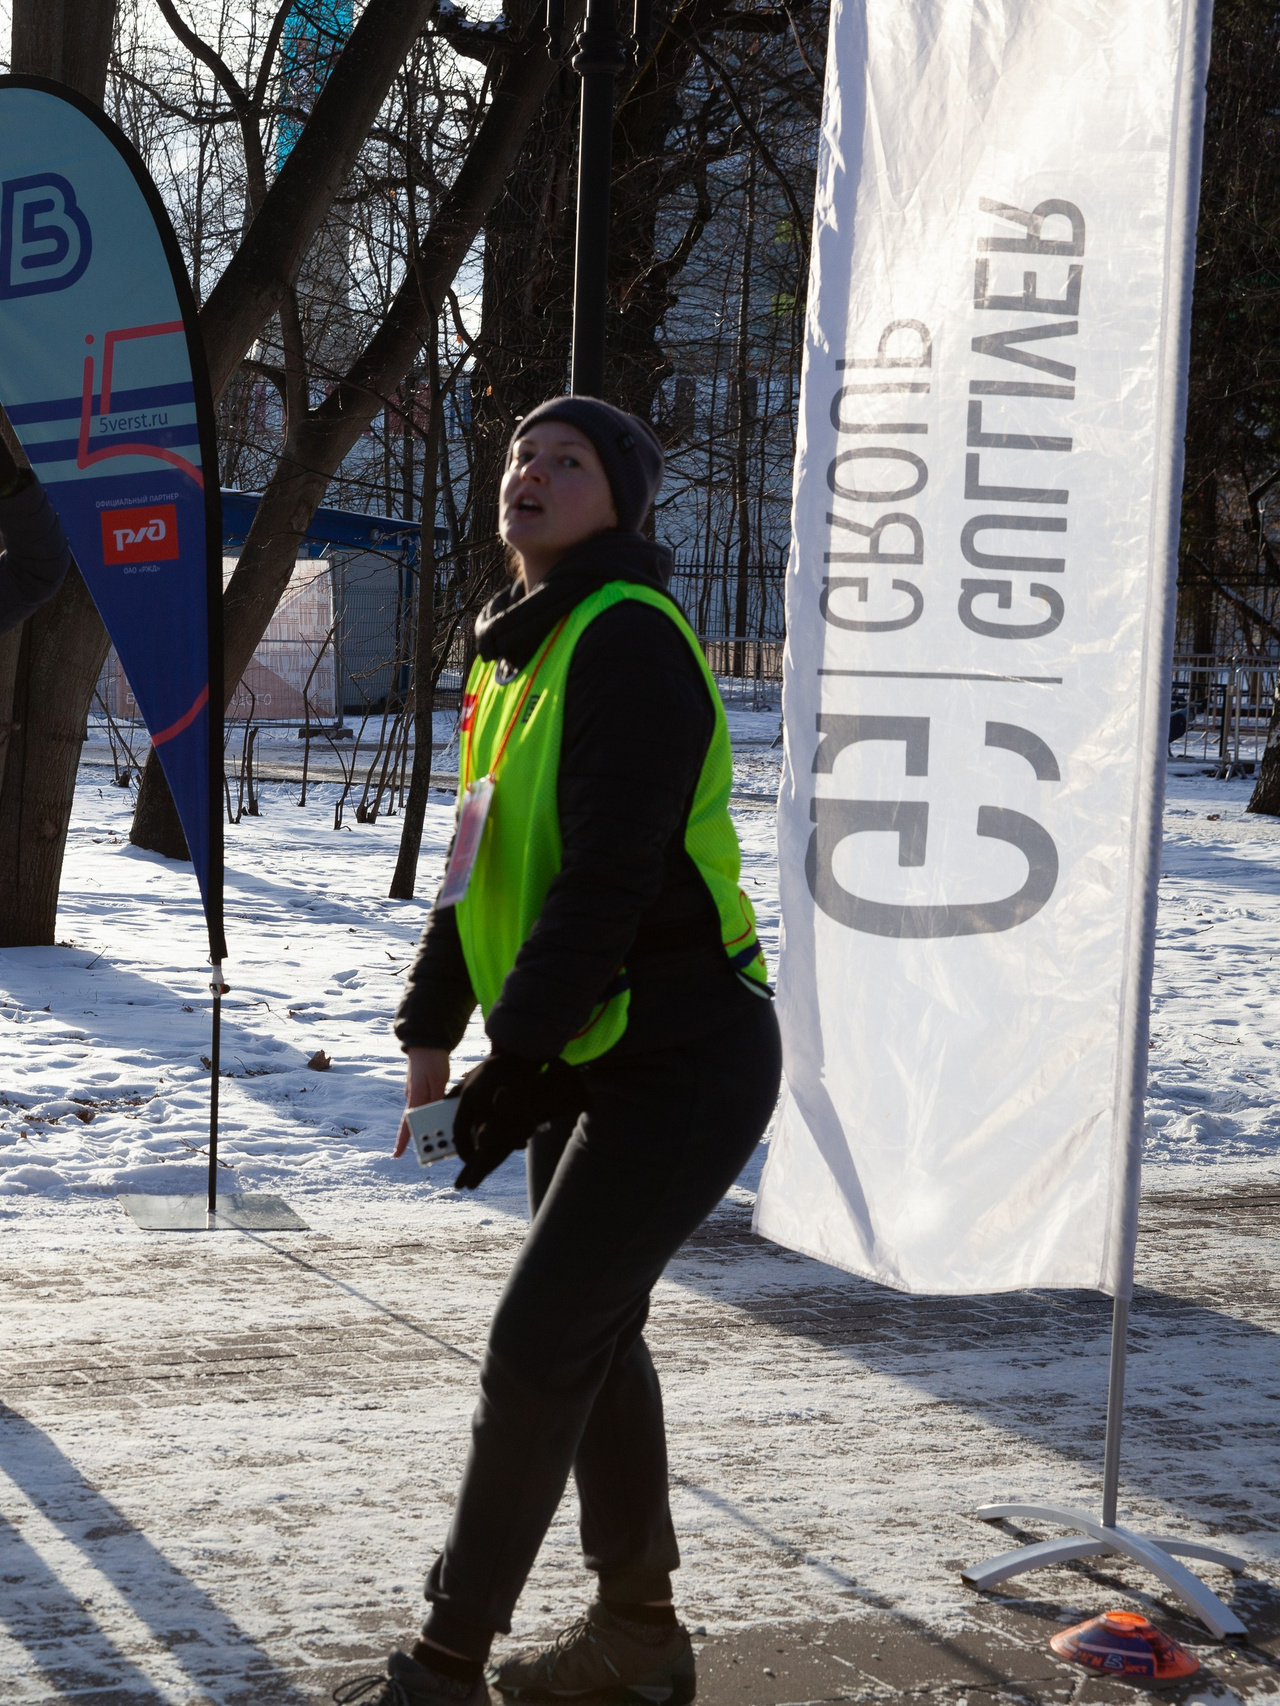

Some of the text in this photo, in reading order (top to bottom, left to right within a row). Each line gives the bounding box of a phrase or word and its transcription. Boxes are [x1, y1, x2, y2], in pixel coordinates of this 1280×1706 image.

[99, 411, 169, 433] 5verst.ru
[95, 492, 180, 508] ОФИЦИАЛЬНЫЙ ПАРТНЕР
[123, 565, 137, 574] ОАО
